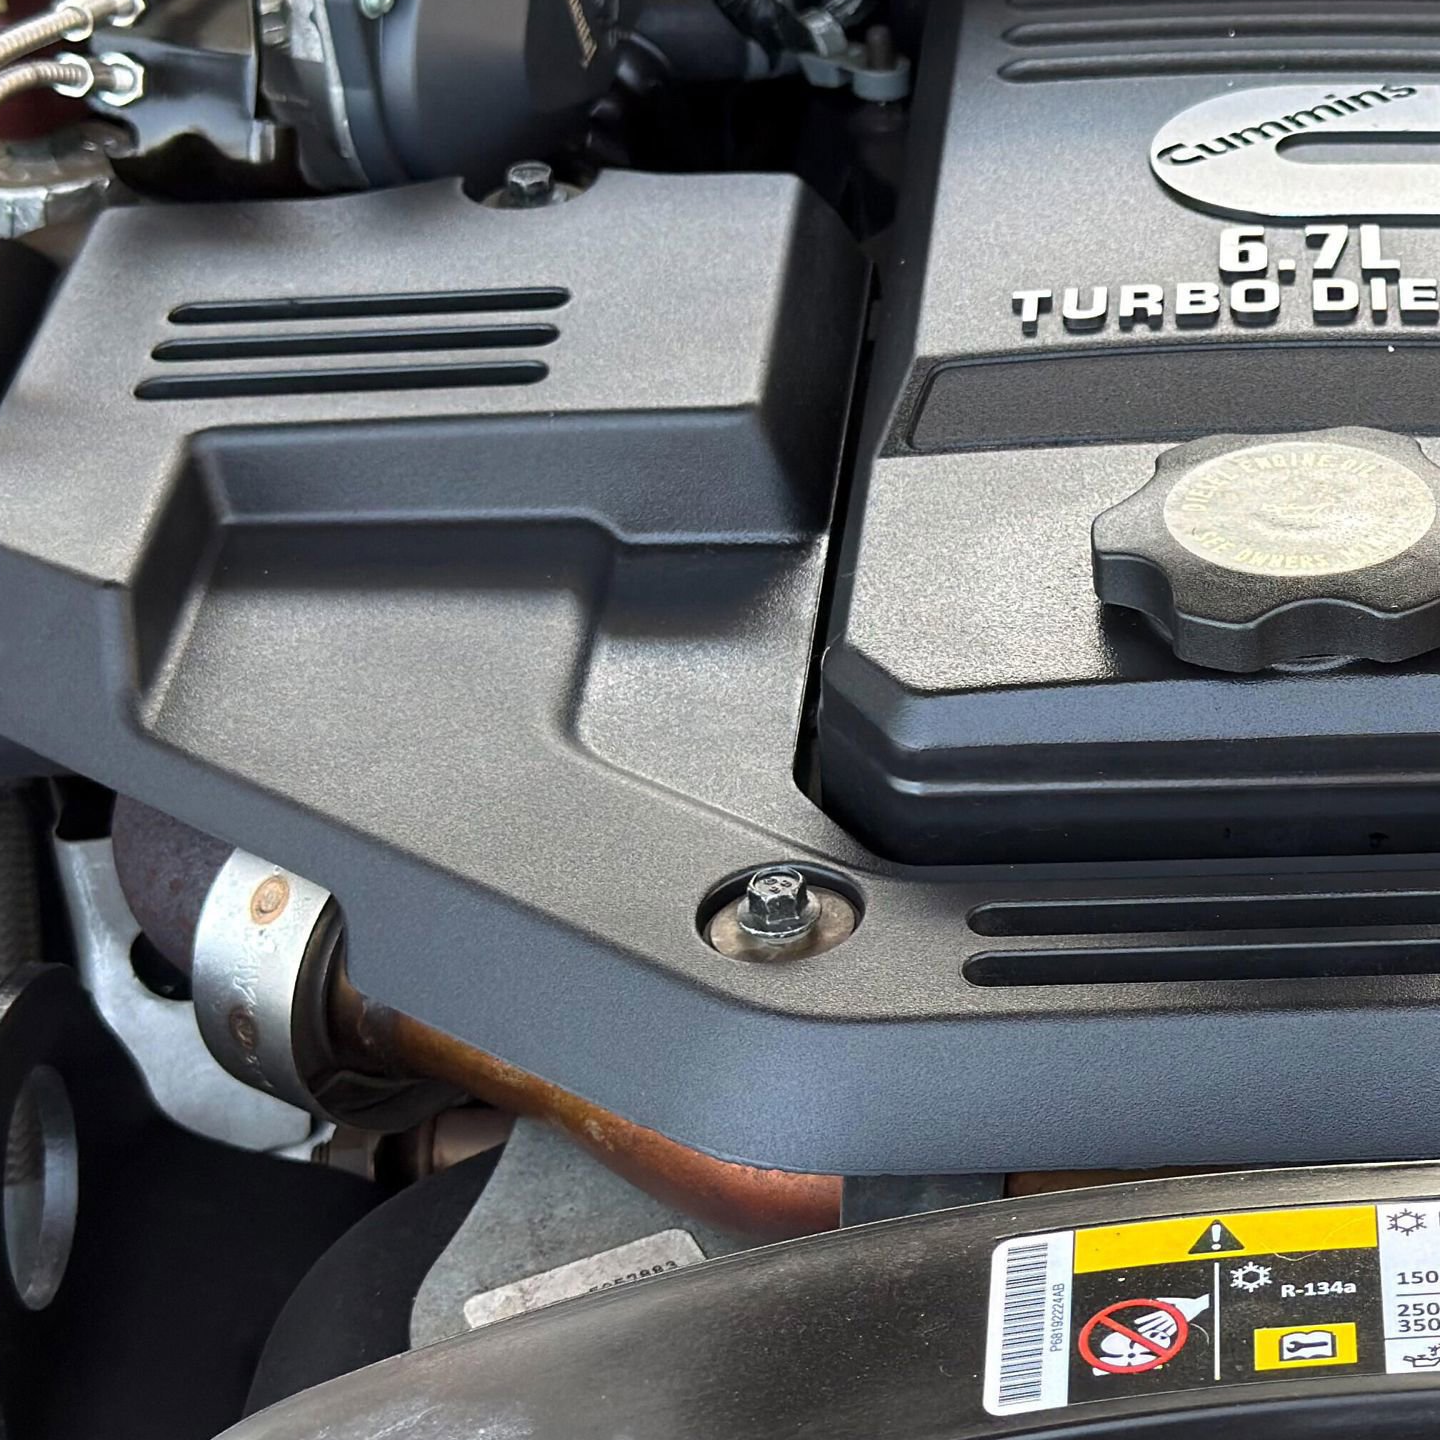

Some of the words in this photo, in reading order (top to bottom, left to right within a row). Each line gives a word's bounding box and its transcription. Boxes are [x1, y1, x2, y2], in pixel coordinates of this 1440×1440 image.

[1156, 82, 1418, 167] Cummins
[1218, 224, 1401, 278] 6.7L
[1012, 278, 1281, 332] TURBO
[1280, 1281, 1357, 1298] R-134a
[1049, 1282, 1066, 1353] P68192224AB
